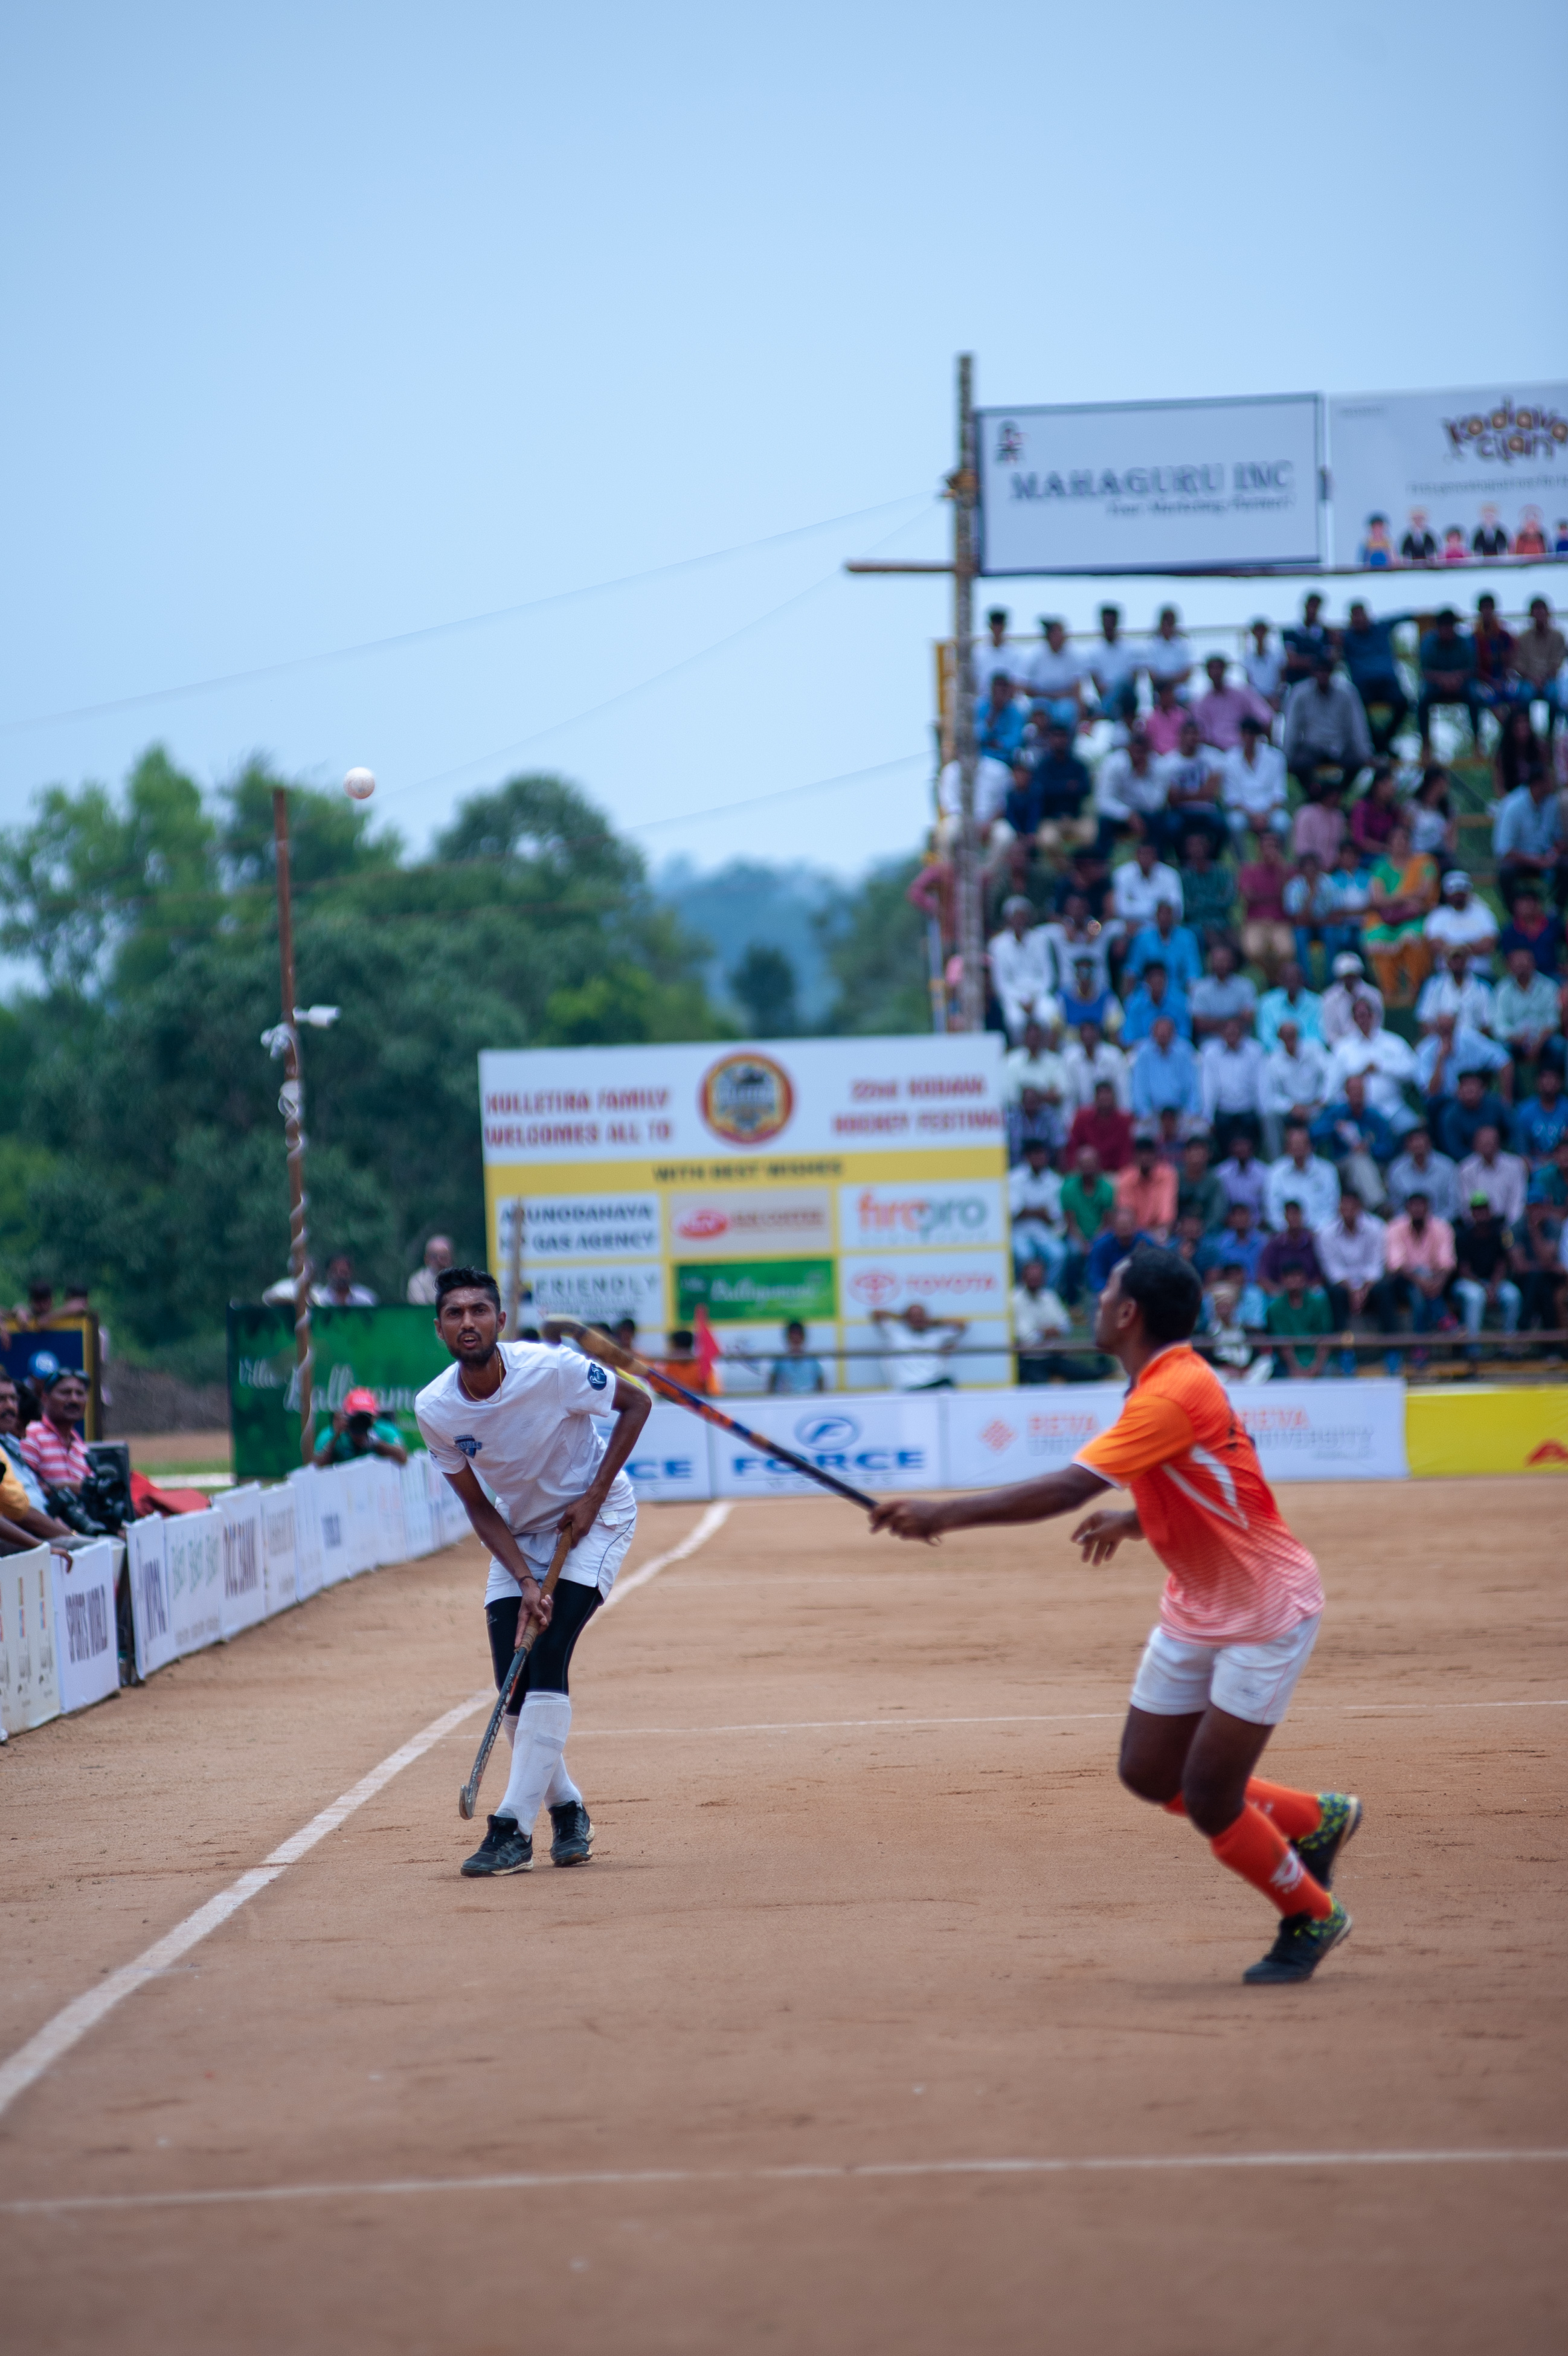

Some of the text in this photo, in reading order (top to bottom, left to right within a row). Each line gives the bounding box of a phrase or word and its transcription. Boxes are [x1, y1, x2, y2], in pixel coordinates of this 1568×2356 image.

[1011, 459, 1294, 499] MAHAGURU INC
[484, 1120, 670, 1146] WELCOMES ALL TO
[576, 1231, 655, 1251] AGENCY
[535, 1276, 657, 1298] FRIENDLY
[907, 1275, 997, 1295] TOYOTA
[733, 1451, 924, 1478] FORCE
